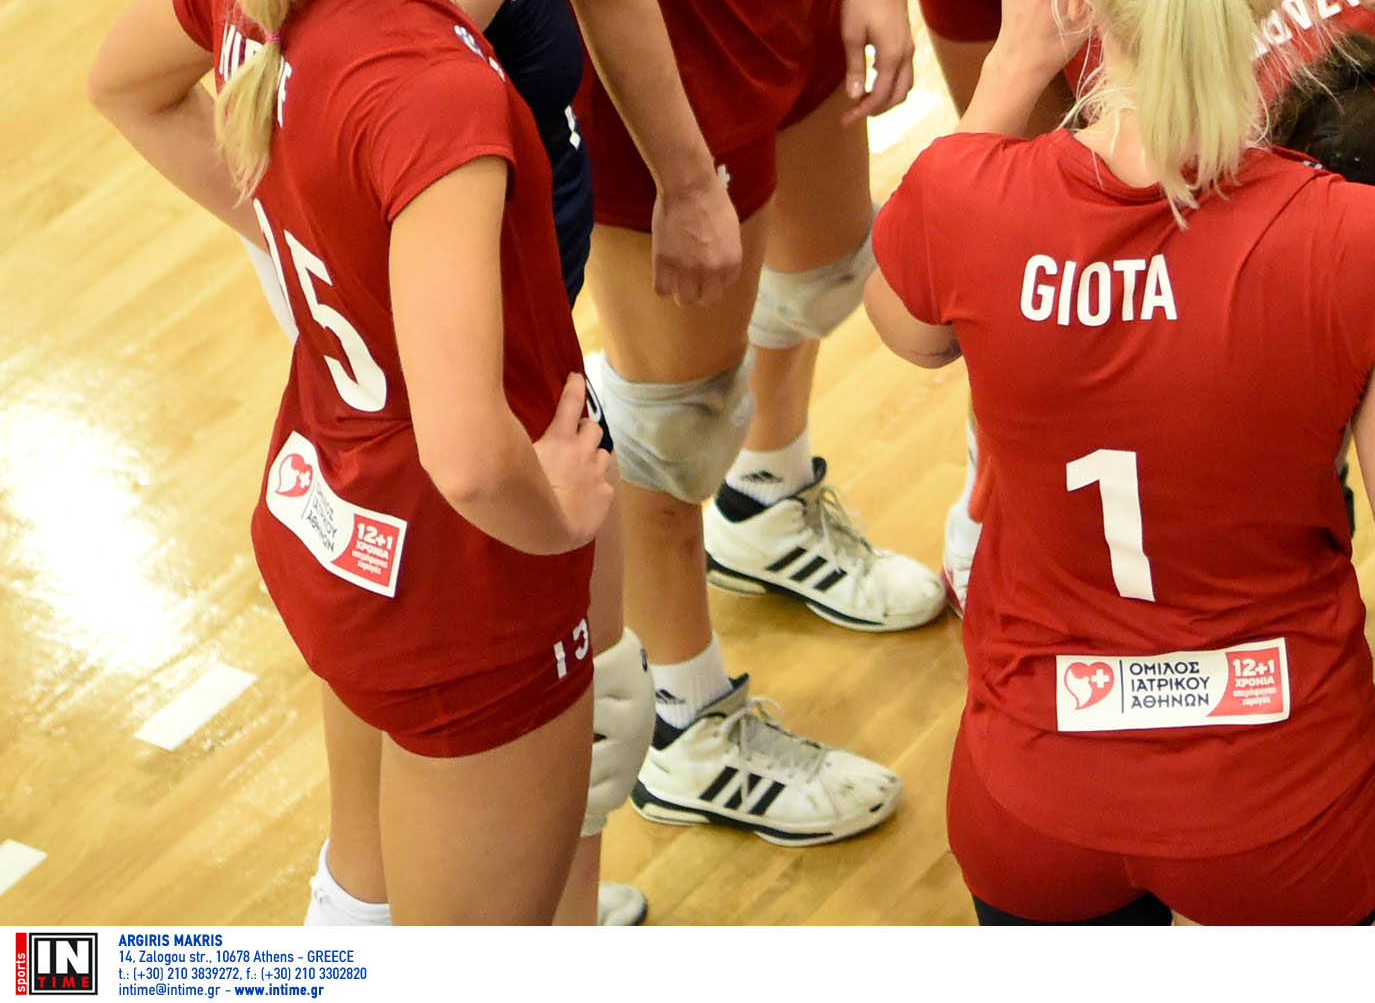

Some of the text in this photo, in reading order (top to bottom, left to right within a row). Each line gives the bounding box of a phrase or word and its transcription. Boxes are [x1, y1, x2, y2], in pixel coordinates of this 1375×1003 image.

[1020, 253, 1178, 327] GIOTA
[1066, 448, 1156, 603] 1
[356, 523, 394, 550] 12+1
[1129, 661, 1200, 676] ΟΜΙΛΟΣ
[1232, 658, 1275, 677] 12+1
[1131, 676, 1210, 692] ΙΑΤΡΙΚΟΥ
[1234, 676, 1275, 688] ΧΡΟΝΙΑ
[1130, 693, 1209, 710] ΑΘΗΝΩΝ
